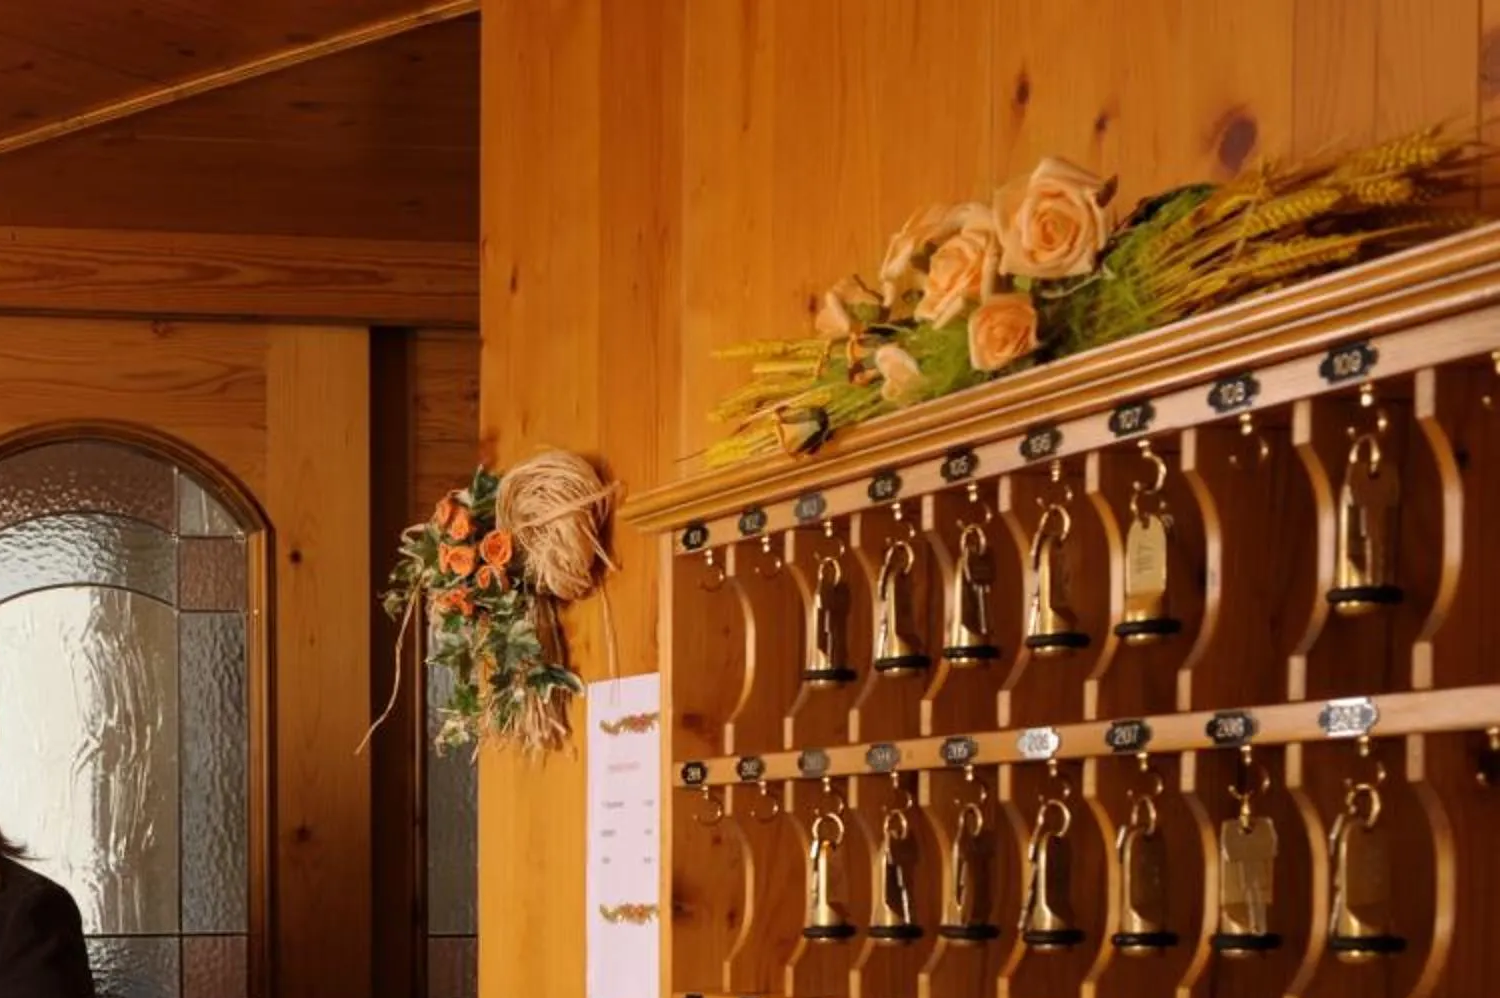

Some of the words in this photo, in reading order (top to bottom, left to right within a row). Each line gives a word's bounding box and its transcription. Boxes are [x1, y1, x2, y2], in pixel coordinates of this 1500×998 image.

[1118, 406, 1142, 430] 107
[1029, 433, 1052, 454] 106
[1114, 723, 1140, 746] 207
